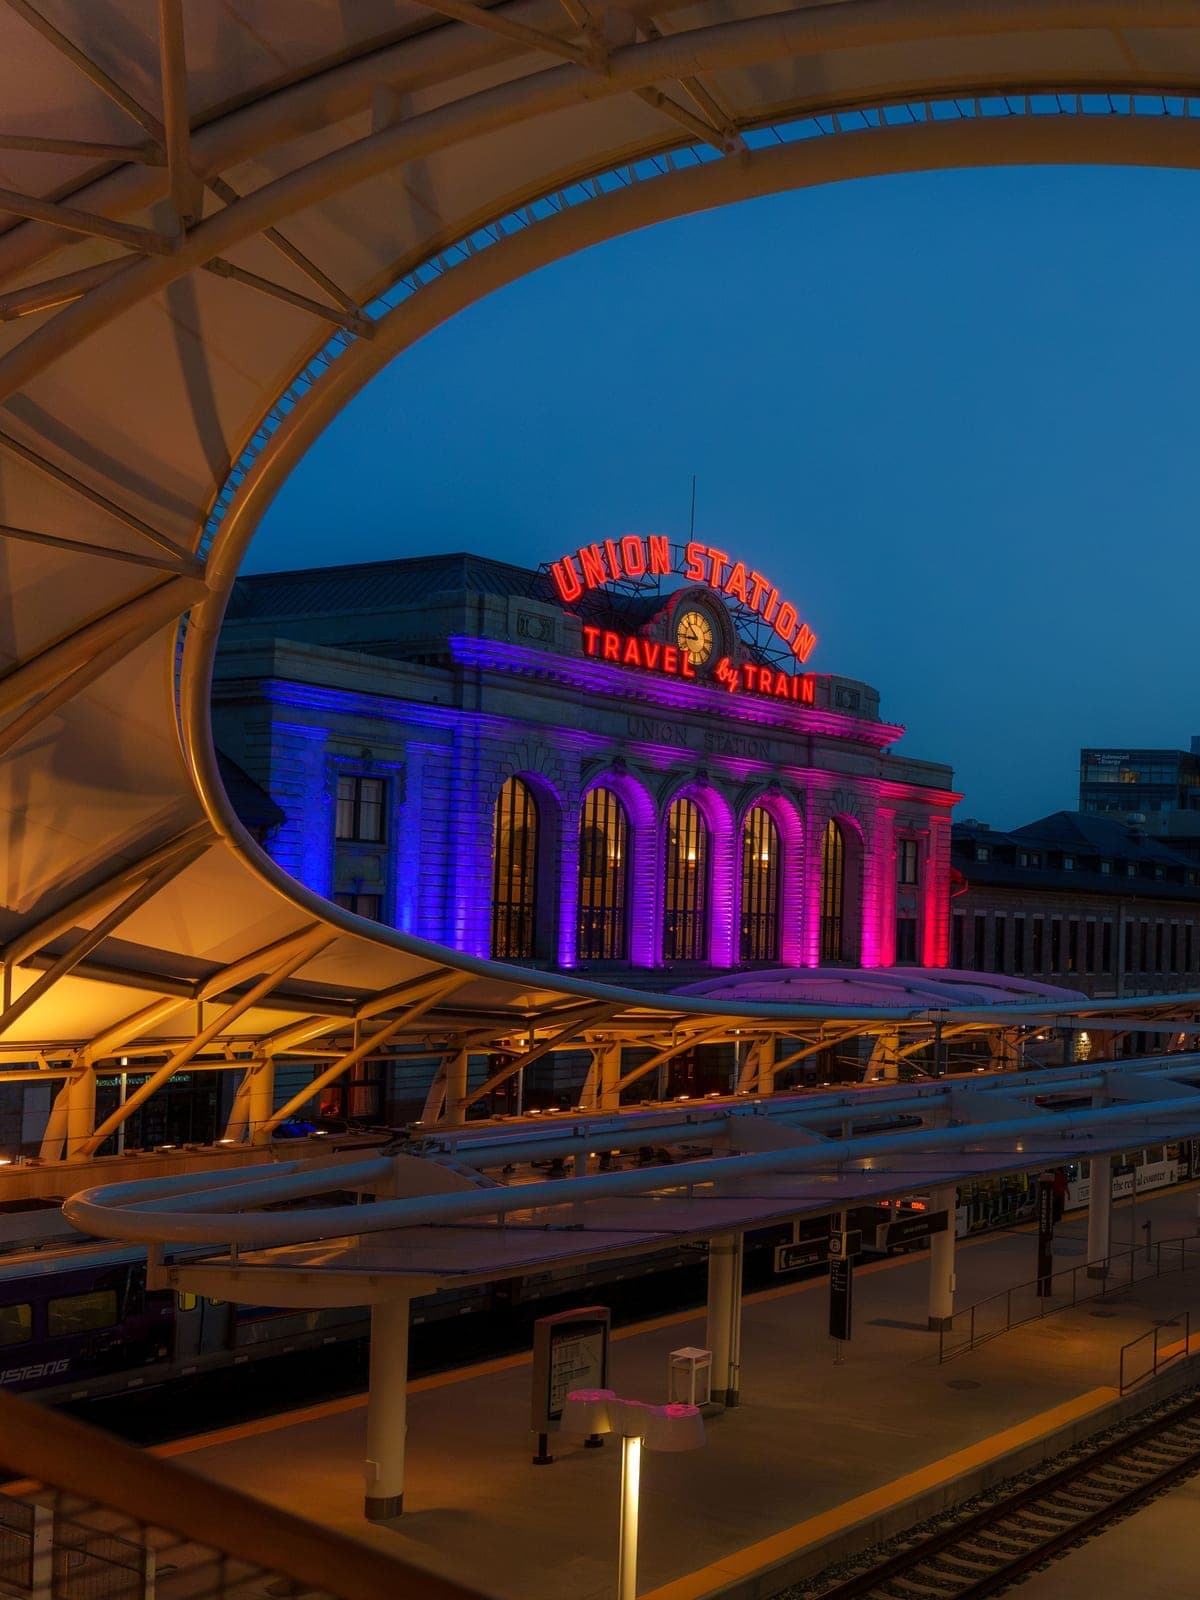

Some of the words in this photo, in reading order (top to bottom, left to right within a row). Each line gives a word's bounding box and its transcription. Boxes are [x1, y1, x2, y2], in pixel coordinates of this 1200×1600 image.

[551, 534, 671, 603] UNION
[684, 541, 818, 664] STATION
[582, 624, 696, 678] TRAVEL
[714, 655, 740, 693] by
[743, 662, 816, 705] TRAIN
[626, 716, 687, 746] UNION
[703, 727, 771, 758] STATION
[1143, 1171, 1165, 1185] counter
